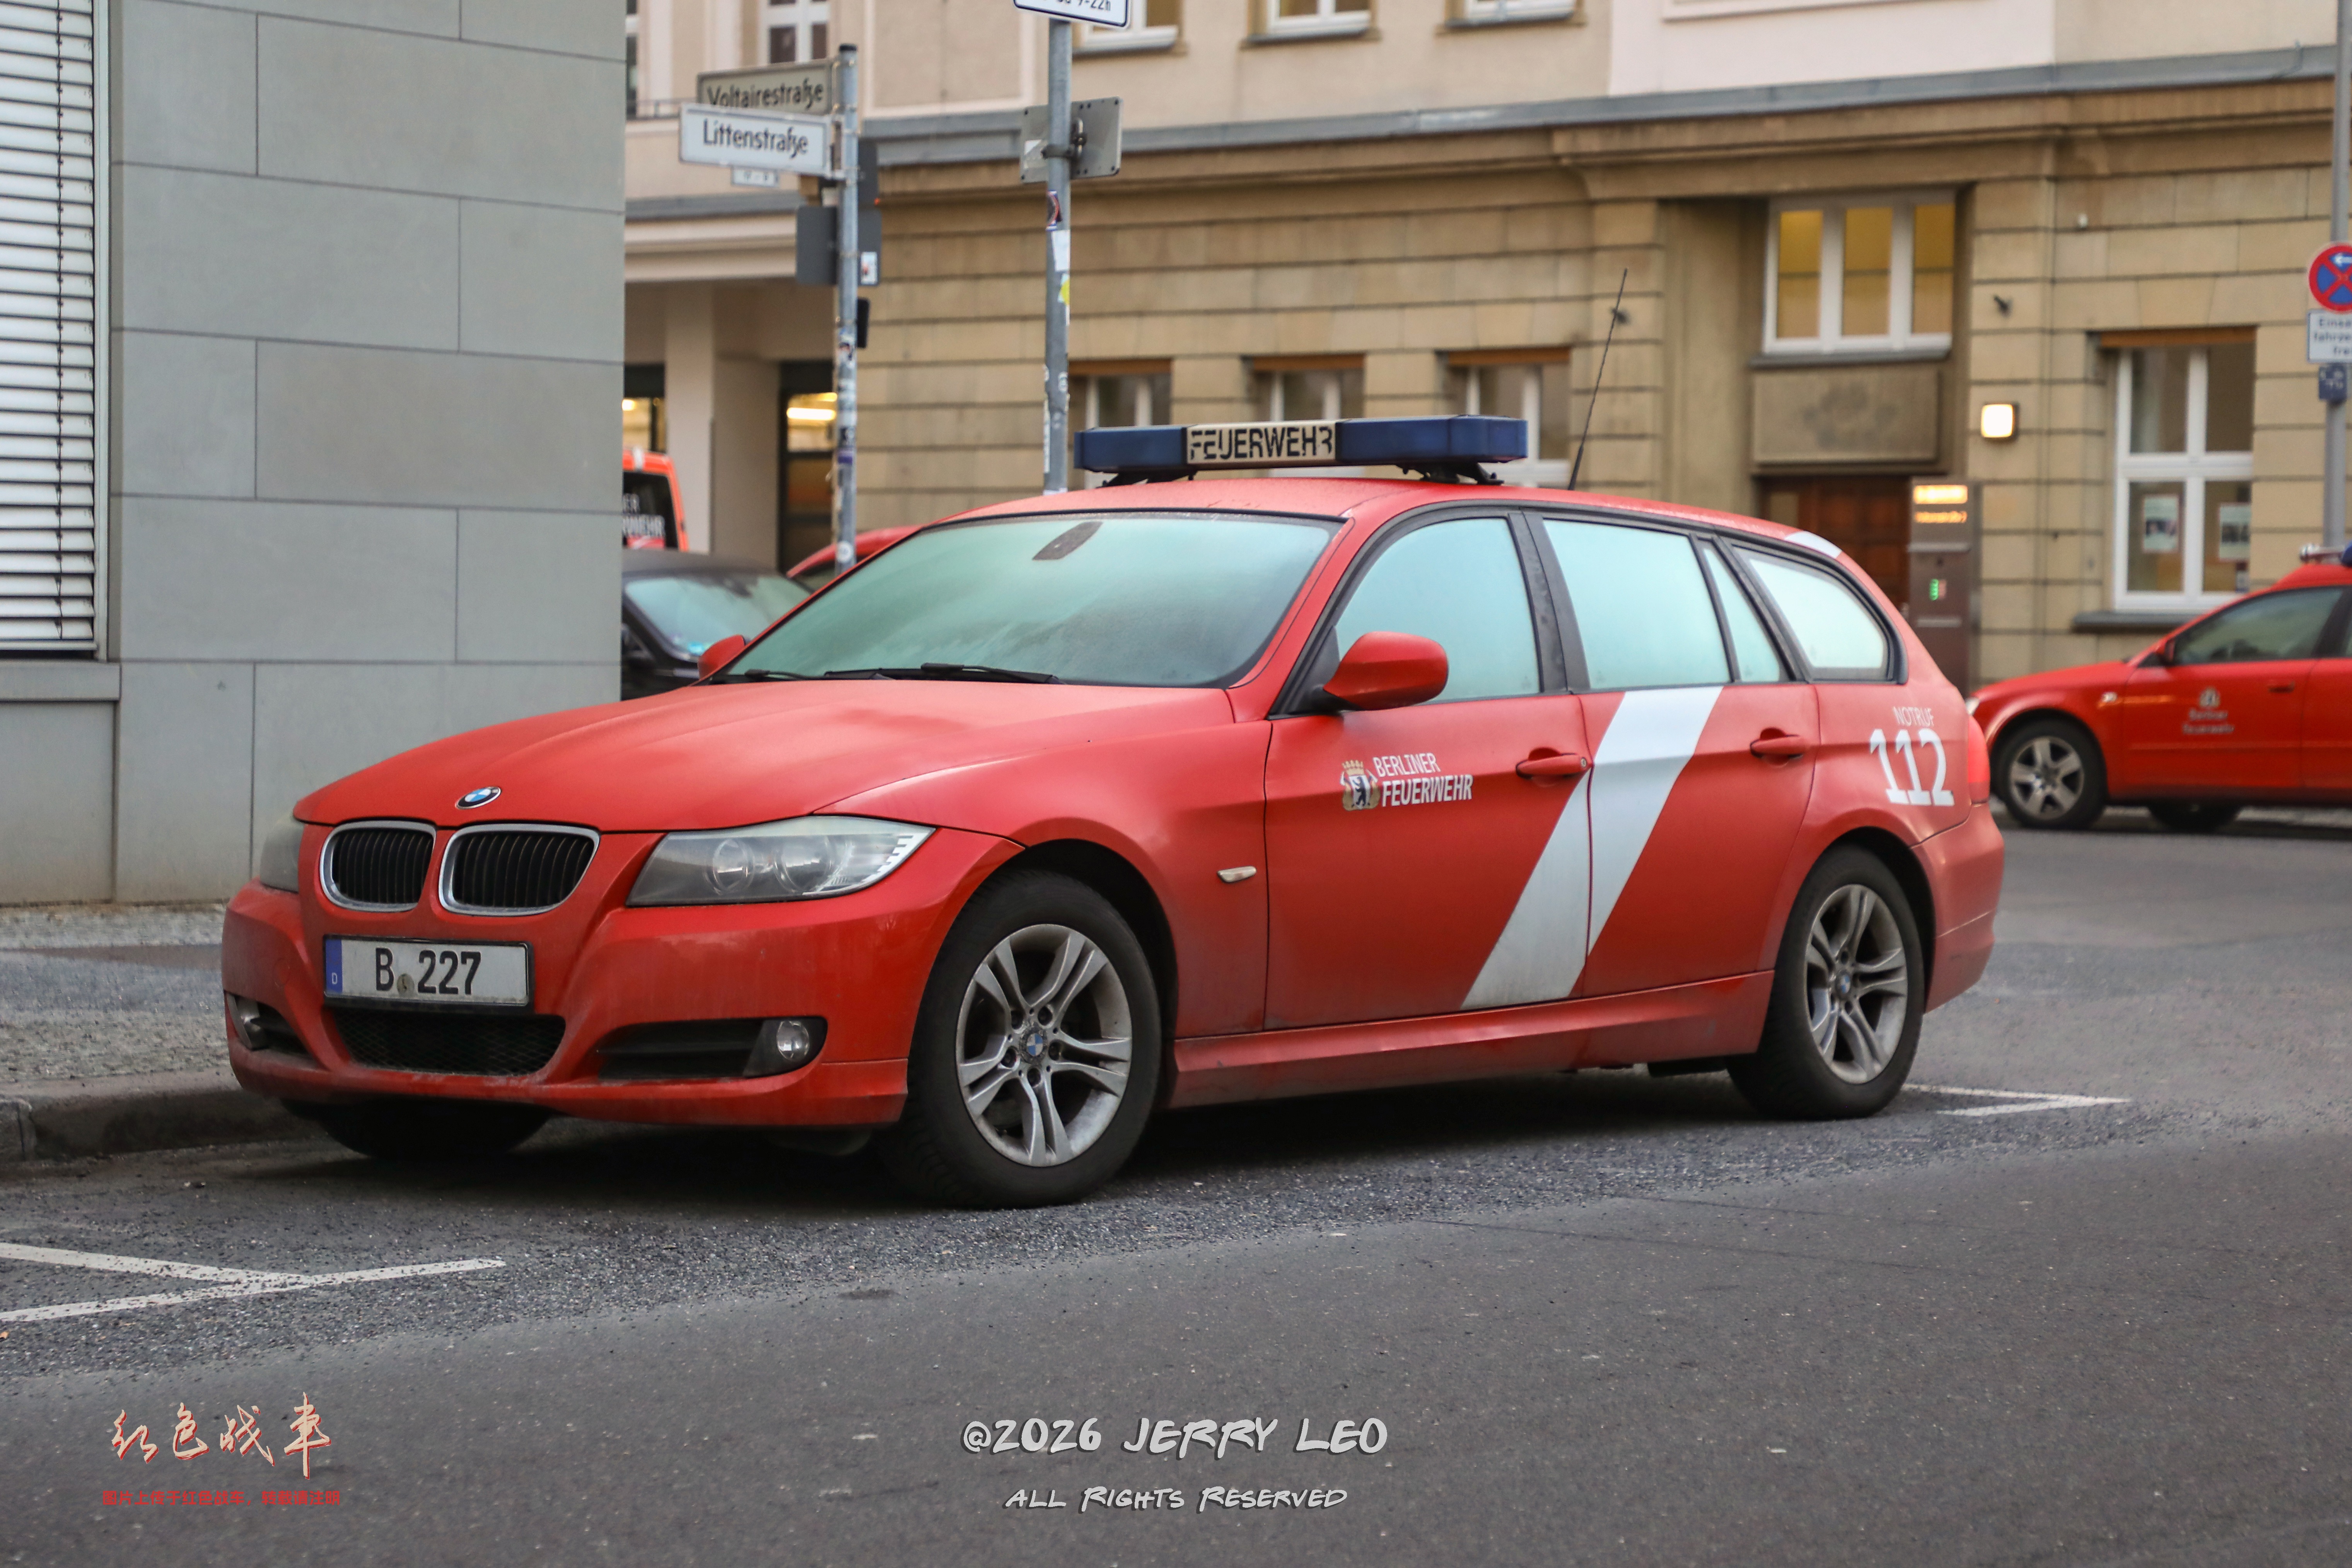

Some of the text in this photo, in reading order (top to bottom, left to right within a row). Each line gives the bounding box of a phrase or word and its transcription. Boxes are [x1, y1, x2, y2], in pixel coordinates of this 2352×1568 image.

[707, 78, 823, 110] Voltairestraße
[703, 118, 808, 159] Littenstraße
[1191, 426, 1333, 460] FEUERWEHR
[1893, 706, 1934, 727] NOTRUF
[1373, 752, 1441, 778] BERLINER
[1870, 728, 1955, 806] 112
[1382, 774, 1473, 807] FEUERWEHR
[331, 972, 338, 985] D
[375, 947, 481, 995] B 227
